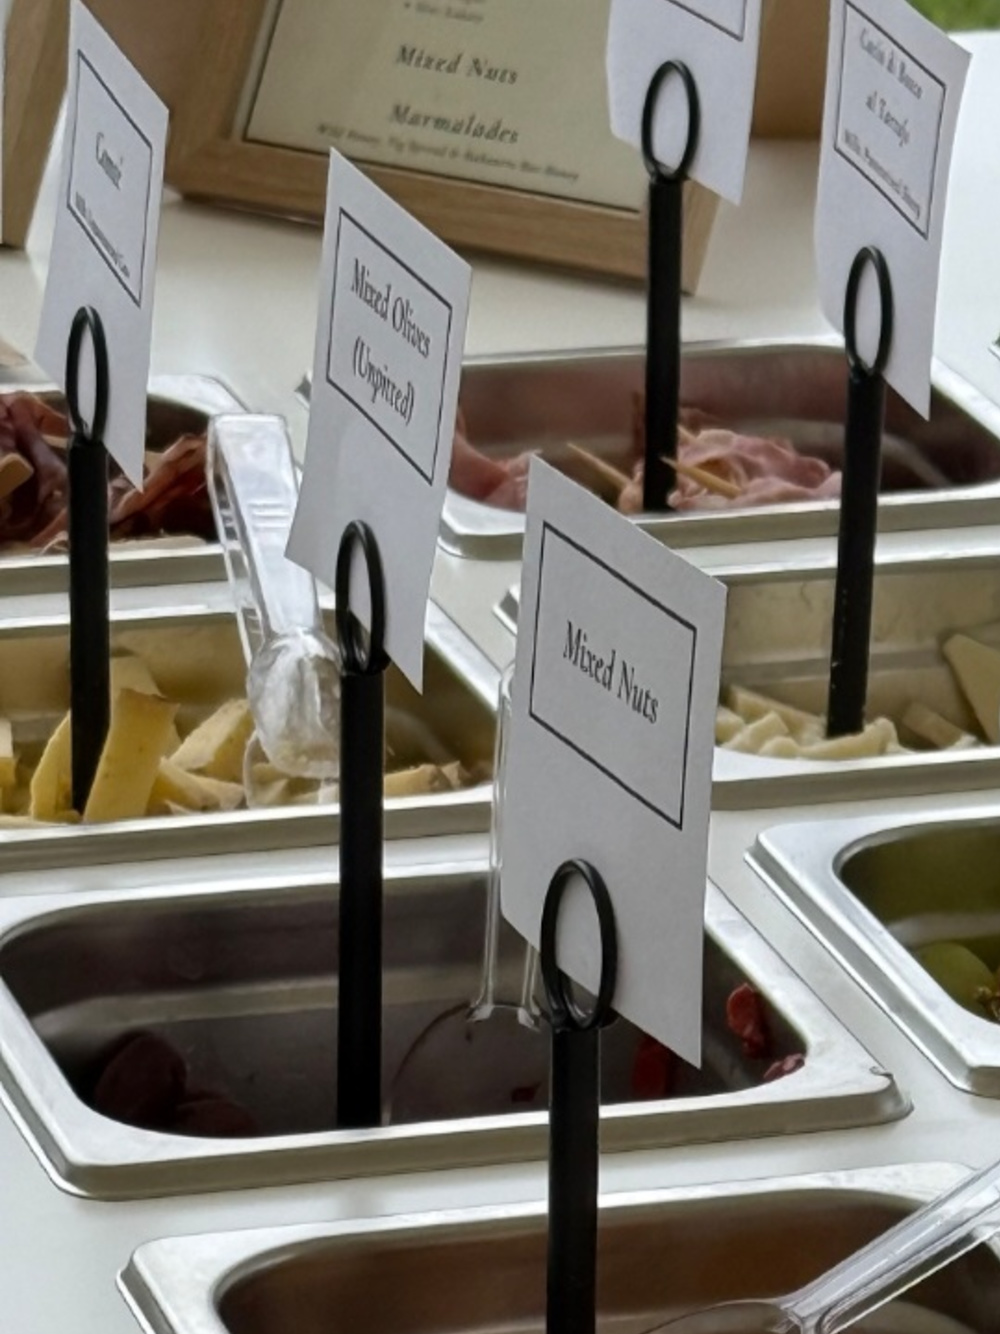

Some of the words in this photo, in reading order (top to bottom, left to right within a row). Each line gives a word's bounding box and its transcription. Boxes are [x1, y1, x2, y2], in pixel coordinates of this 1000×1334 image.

[396, 44, 462, 75] Mixed
[466, 56, 519, 85] Nuts
[390, 103, 520, 145] Marmalades
[351, 257, 392, 322] Mixed
[392, 296, 431, 359] Olives
[352, 335, 415, 426] (Unpitted)
[562, 619, 617, 692] Mixed
[617, 659, 659, 724] Nuts
